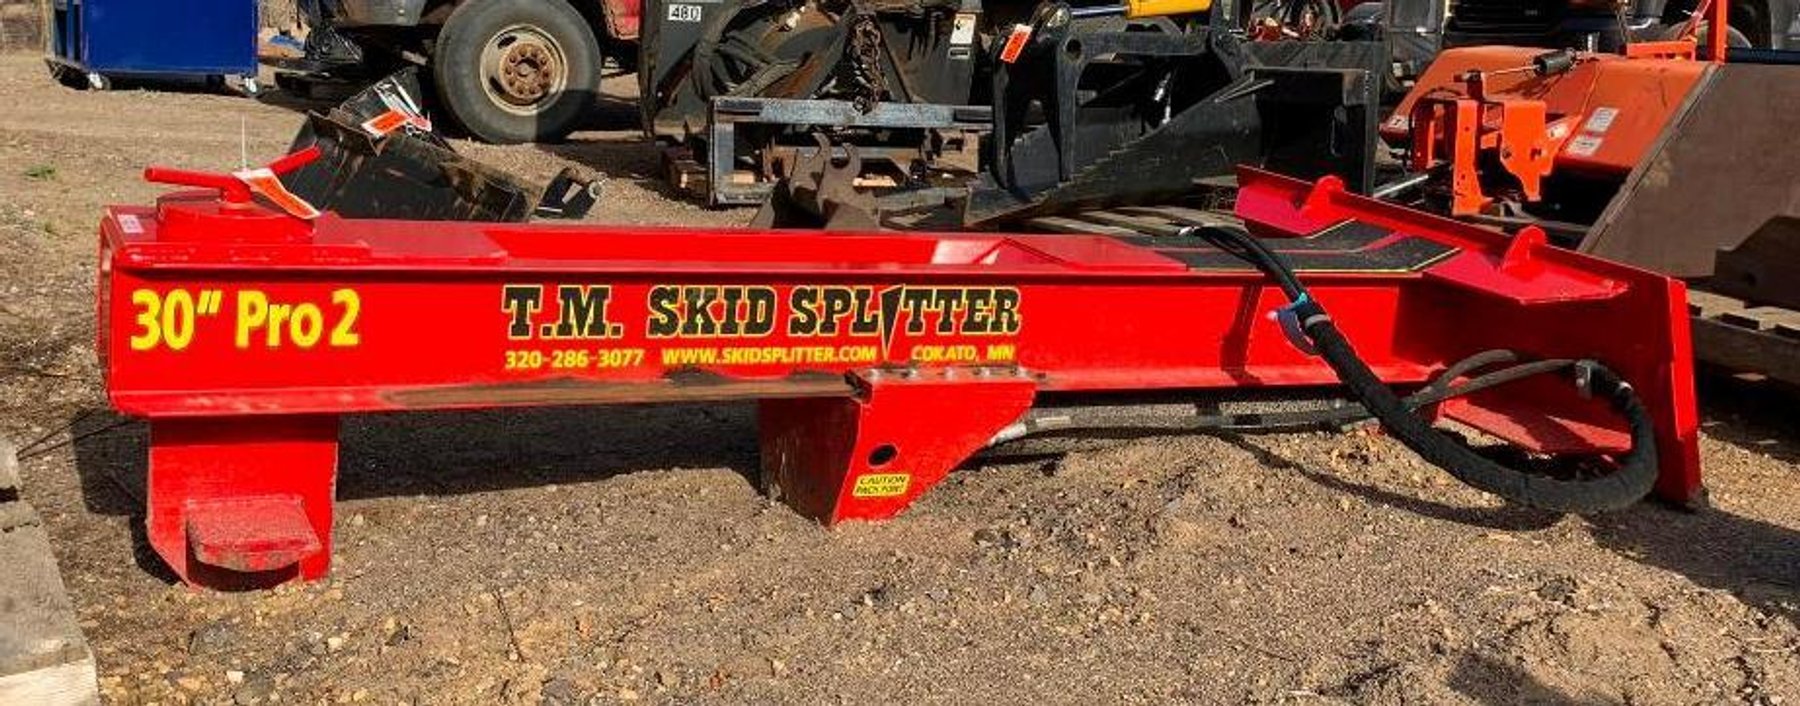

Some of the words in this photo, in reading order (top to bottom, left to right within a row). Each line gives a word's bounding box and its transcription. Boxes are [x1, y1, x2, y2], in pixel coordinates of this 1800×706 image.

[235, 289, 323, 347] Pro
[329, 288, 361, 346] 2
[502, 284, 624, 339] T.M.
[646, 284, 777, 339] SKID
[787, 283, 1022, 361] SPLITTER
[504, 349, 645, 369] 320-286-3077
[661, 346, 877, 365] WWW.SKIDSPLITTER.COM
[911, 345, 979, 363] COKATO,
[987, 345, 1016, 361] MN
[860, 475, 906, 485] CAUTION
